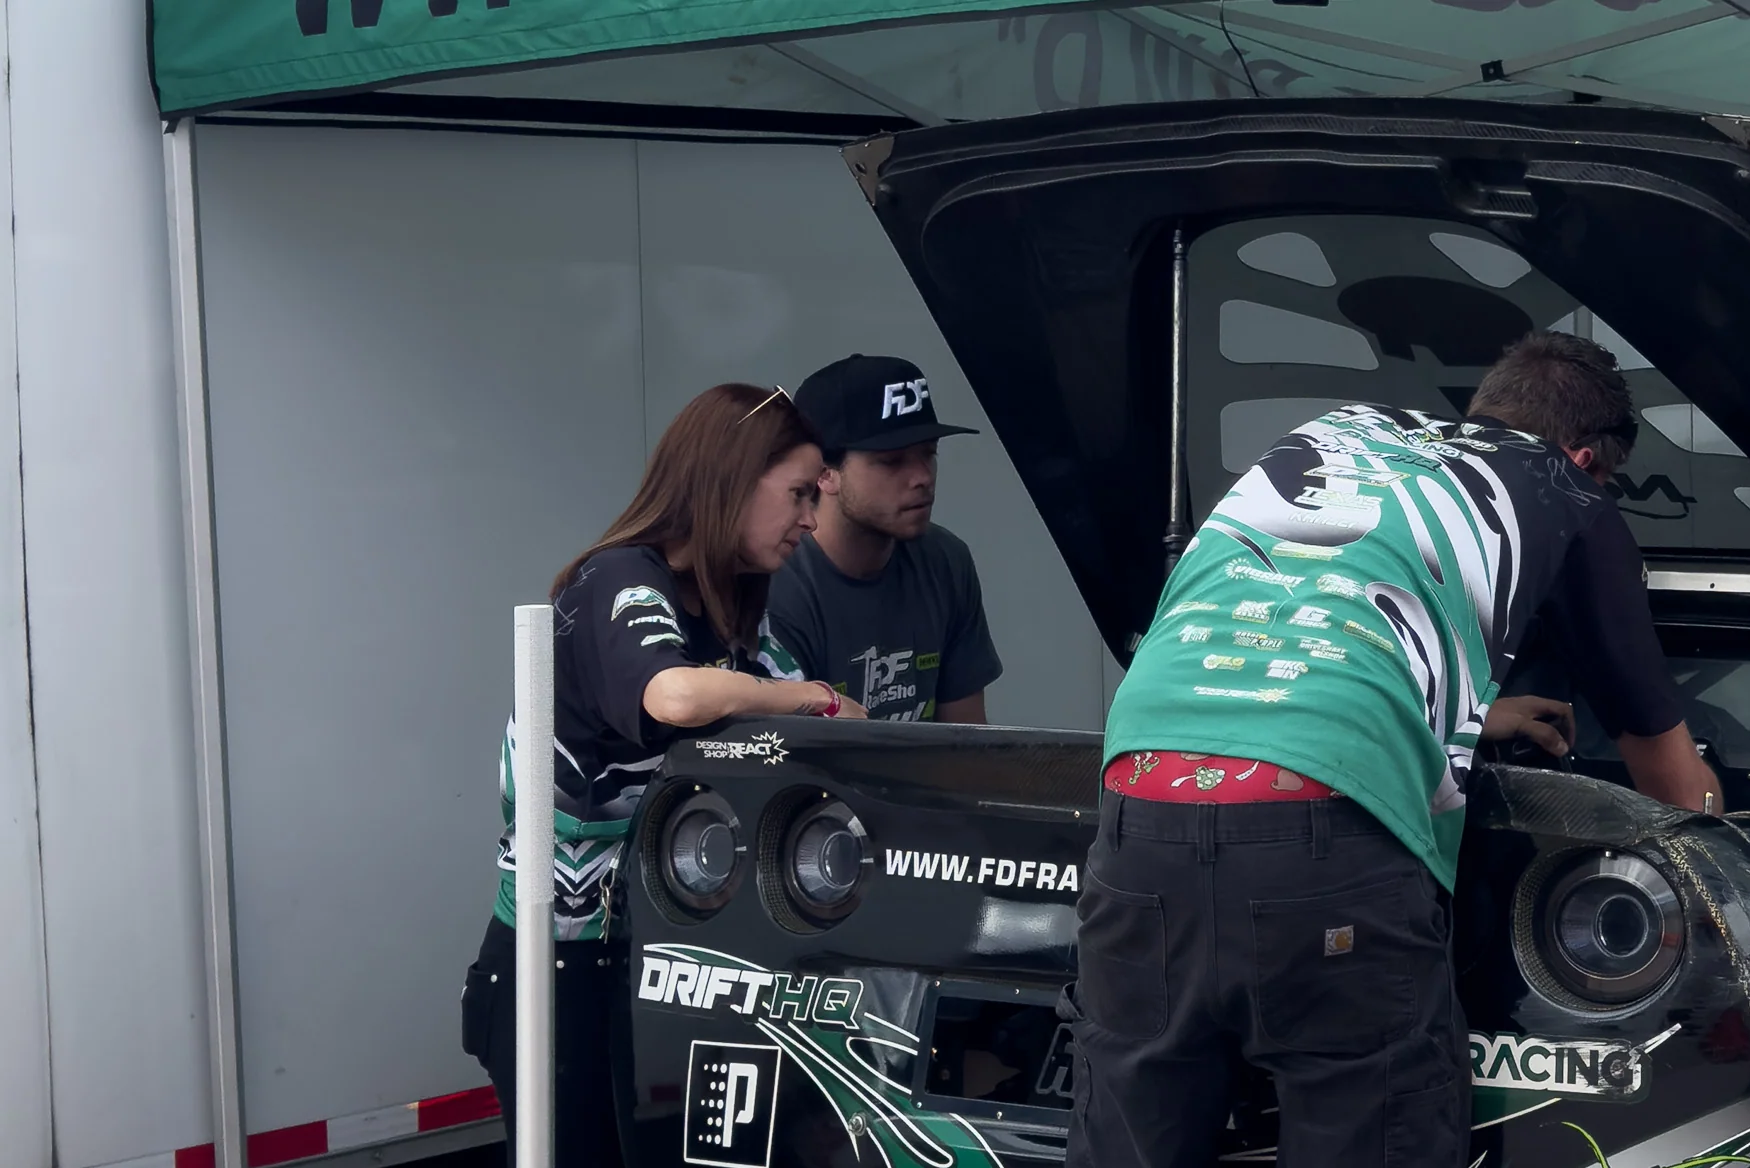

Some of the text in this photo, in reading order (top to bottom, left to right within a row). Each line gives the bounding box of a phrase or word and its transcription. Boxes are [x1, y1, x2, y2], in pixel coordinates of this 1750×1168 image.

[696, 741, 726, 750] DESIGN
[704, 750, 727, 758] SHOP
[728, 742, 772, 759] REACT
